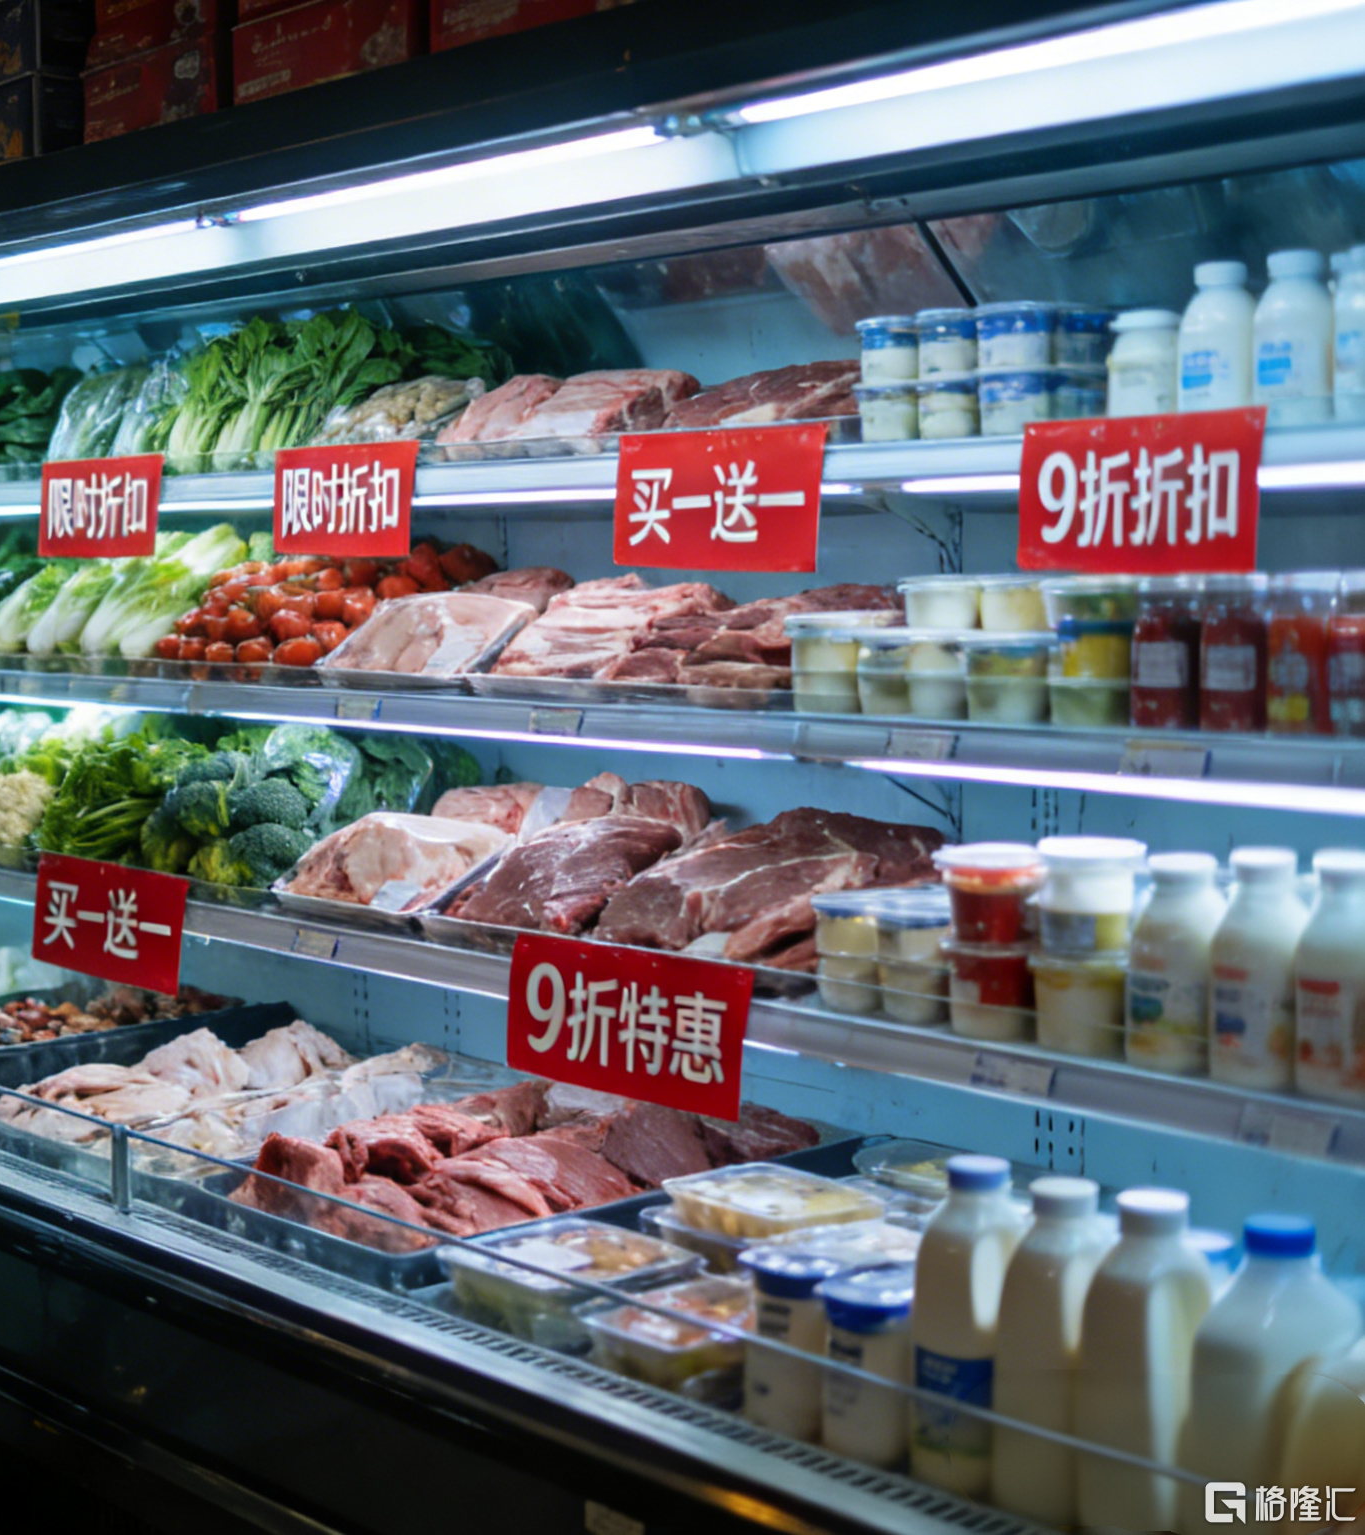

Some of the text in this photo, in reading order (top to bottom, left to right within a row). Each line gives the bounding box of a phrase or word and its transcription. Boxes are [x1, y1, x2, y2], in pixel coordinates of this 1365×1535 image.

[47, 473, 148, 539] 限时折扣
[281, 461, 401, 538] 限时折扣
[628, 461, 806, 545] 买一送一
[1037, 444, 1241, 546] 9折折扣
[43, 880, 172, 960] 买一送一
[525, 962, 729, 1084] 9折特惠
